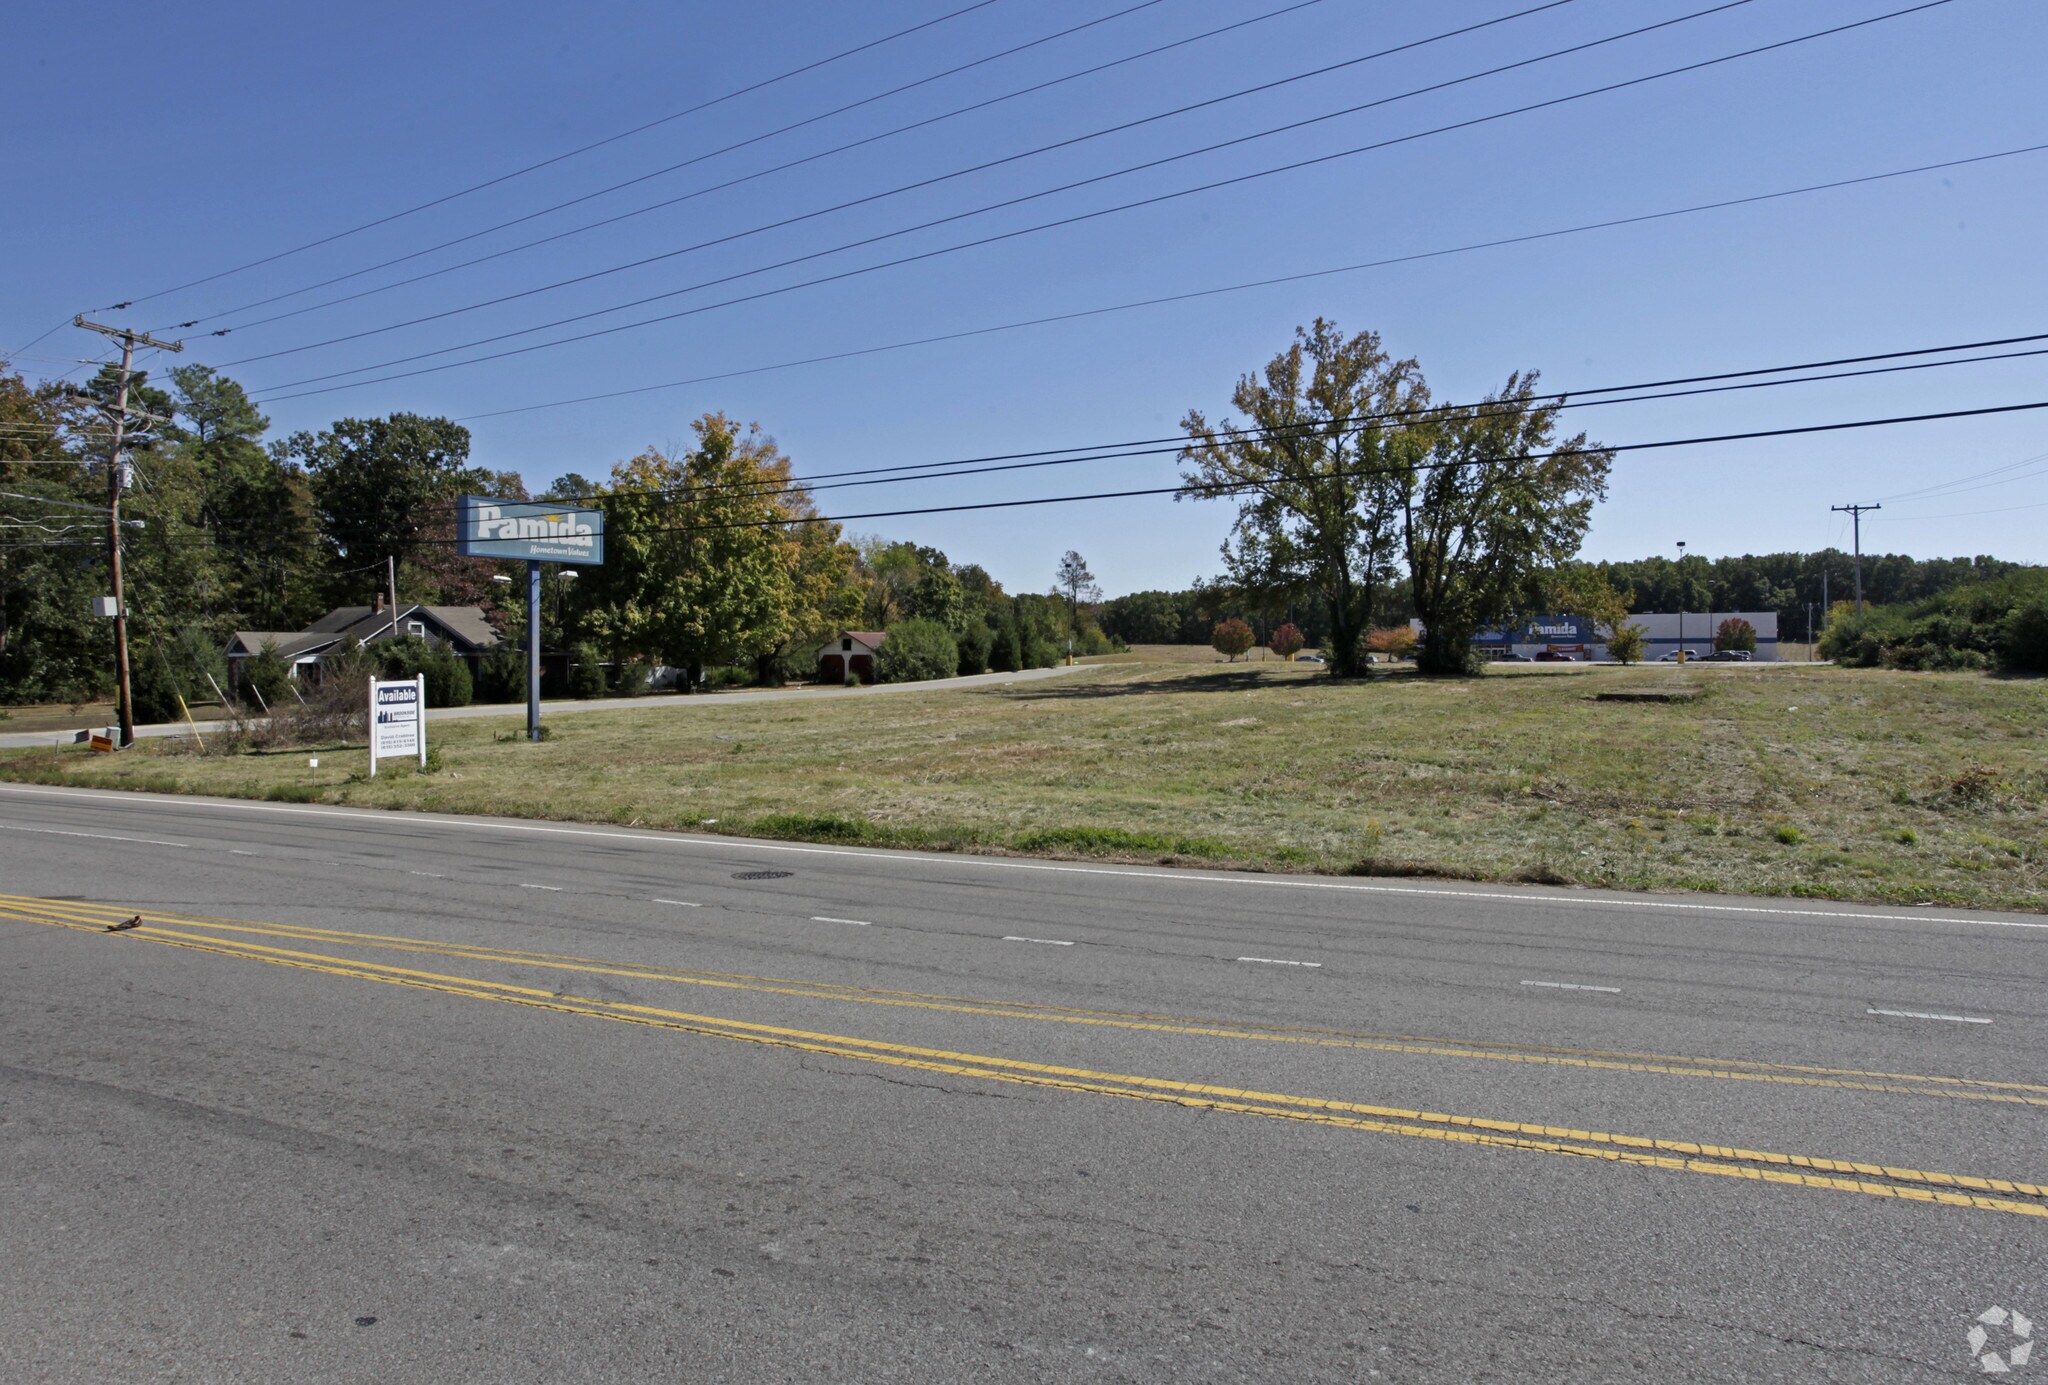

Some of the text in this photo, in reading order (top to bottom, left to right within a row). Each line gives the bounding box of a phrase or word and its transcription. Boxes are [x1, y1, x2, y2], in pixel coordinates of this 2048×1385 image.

[478, 503, 593, 547] Pamida
[530, 545, 590, 557] Hometown Values
[379, 689, 416, 702] Available
